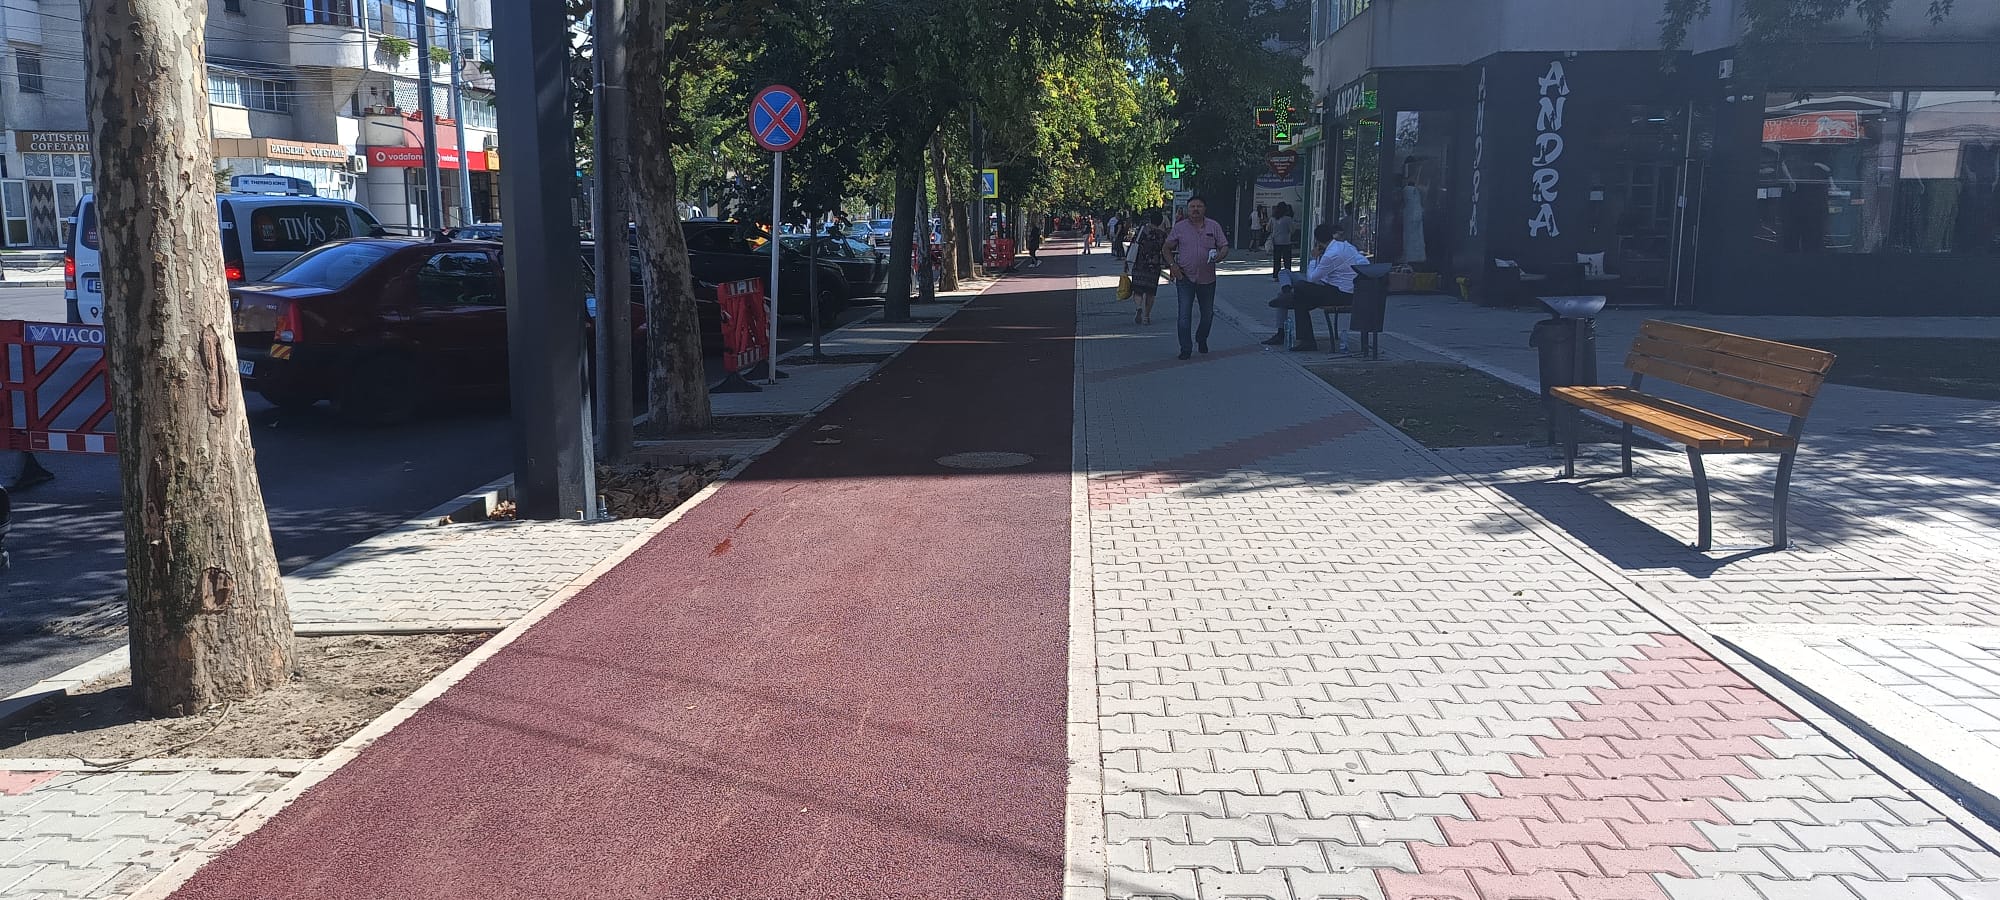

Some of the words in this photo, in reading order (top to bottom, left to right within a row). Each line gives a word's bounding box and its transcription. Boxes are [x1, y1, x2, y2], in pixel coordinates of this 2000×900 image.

[1334, 81, 1365, 119] ANDRA
[30, 142, 89, 151] COFETARI
[271, 144, 305, 155] PATISERIE
[441, 154, 459, 162] vodafon
[1528, 60, 1570, 237] ANDRA
[279, 211, 326, 246] TIVAS
